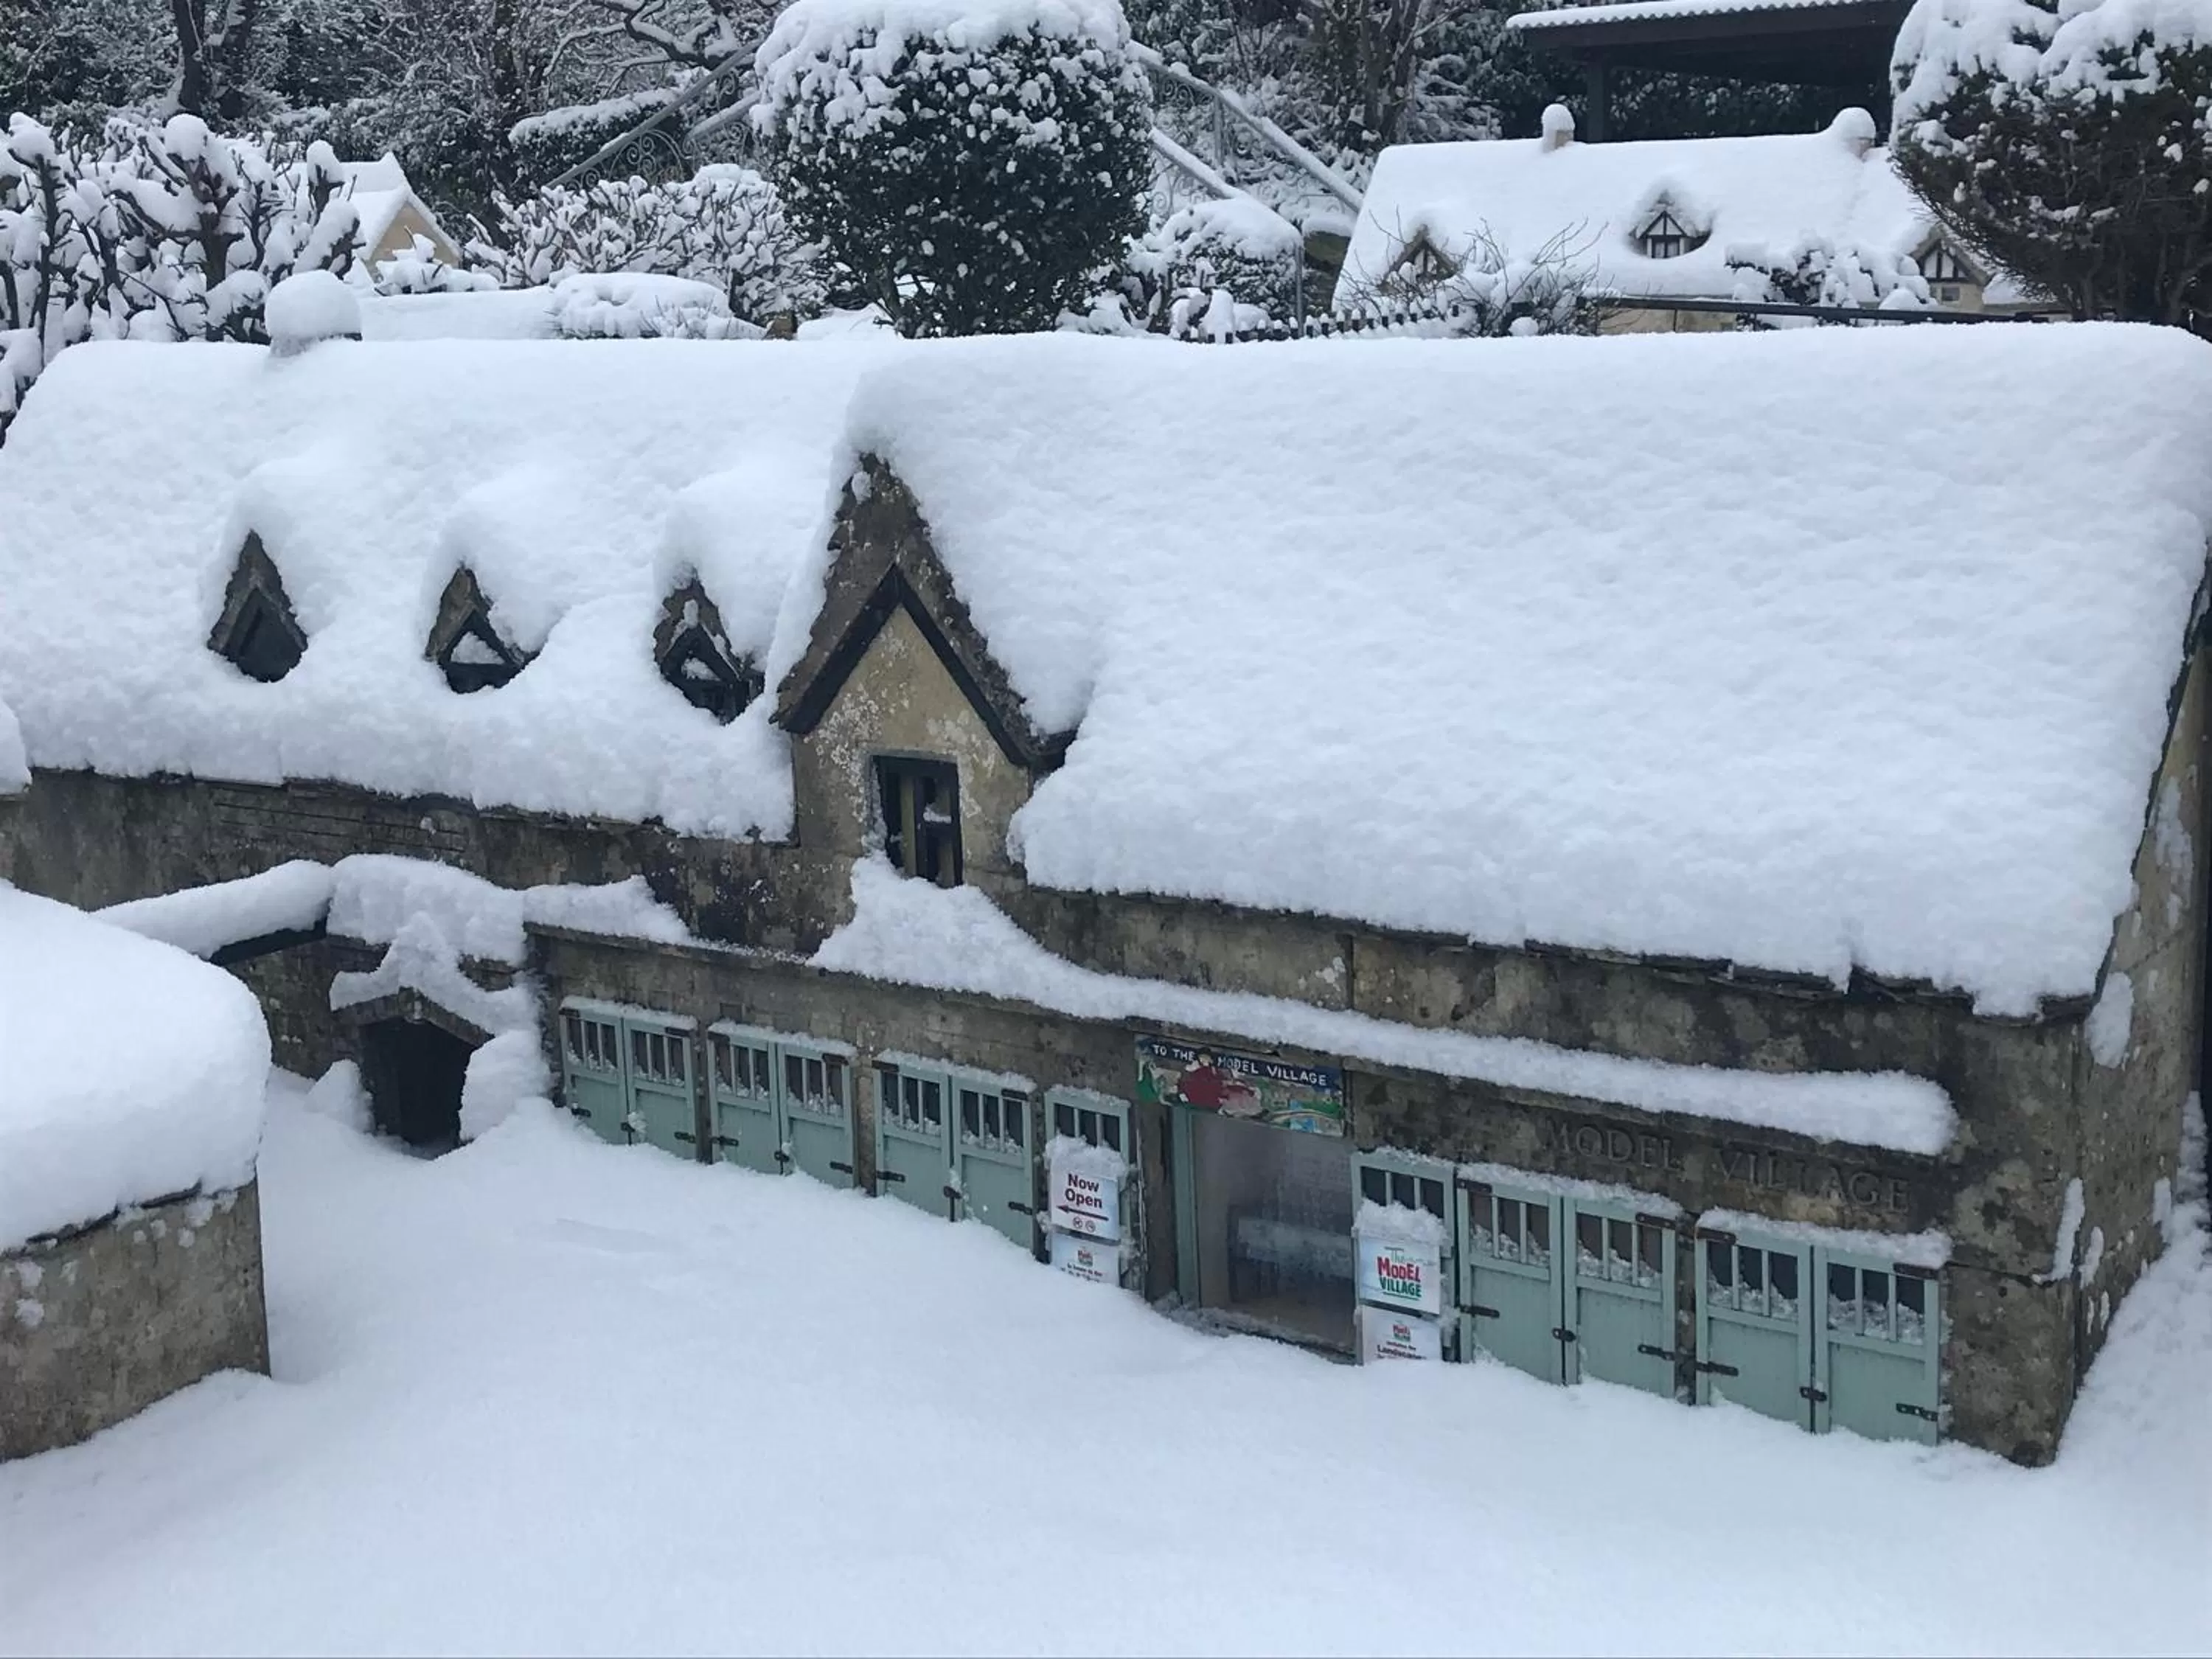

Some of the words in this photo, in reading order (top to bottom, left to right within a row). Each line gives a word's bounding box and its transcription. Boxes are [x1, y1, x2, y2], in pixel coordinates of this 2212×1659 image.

[1152, 1044, 1167, 1056] TO
[1172, 1048, 1195, 1061] THE
[1217, 1056, 1259, 1074] MODEL
[1267, 1065, 1326, 1086] VILLAGE
[1543, 1117, 1677, 1169] MODEL
[1714, 1150, 1909, 1212] VILLAGE
[1068, 1173, 1099, 1192] Now
[1065, 1188, 1102, 1208] Open
[1380, 1276, 1422, 1298] VILLAGE
